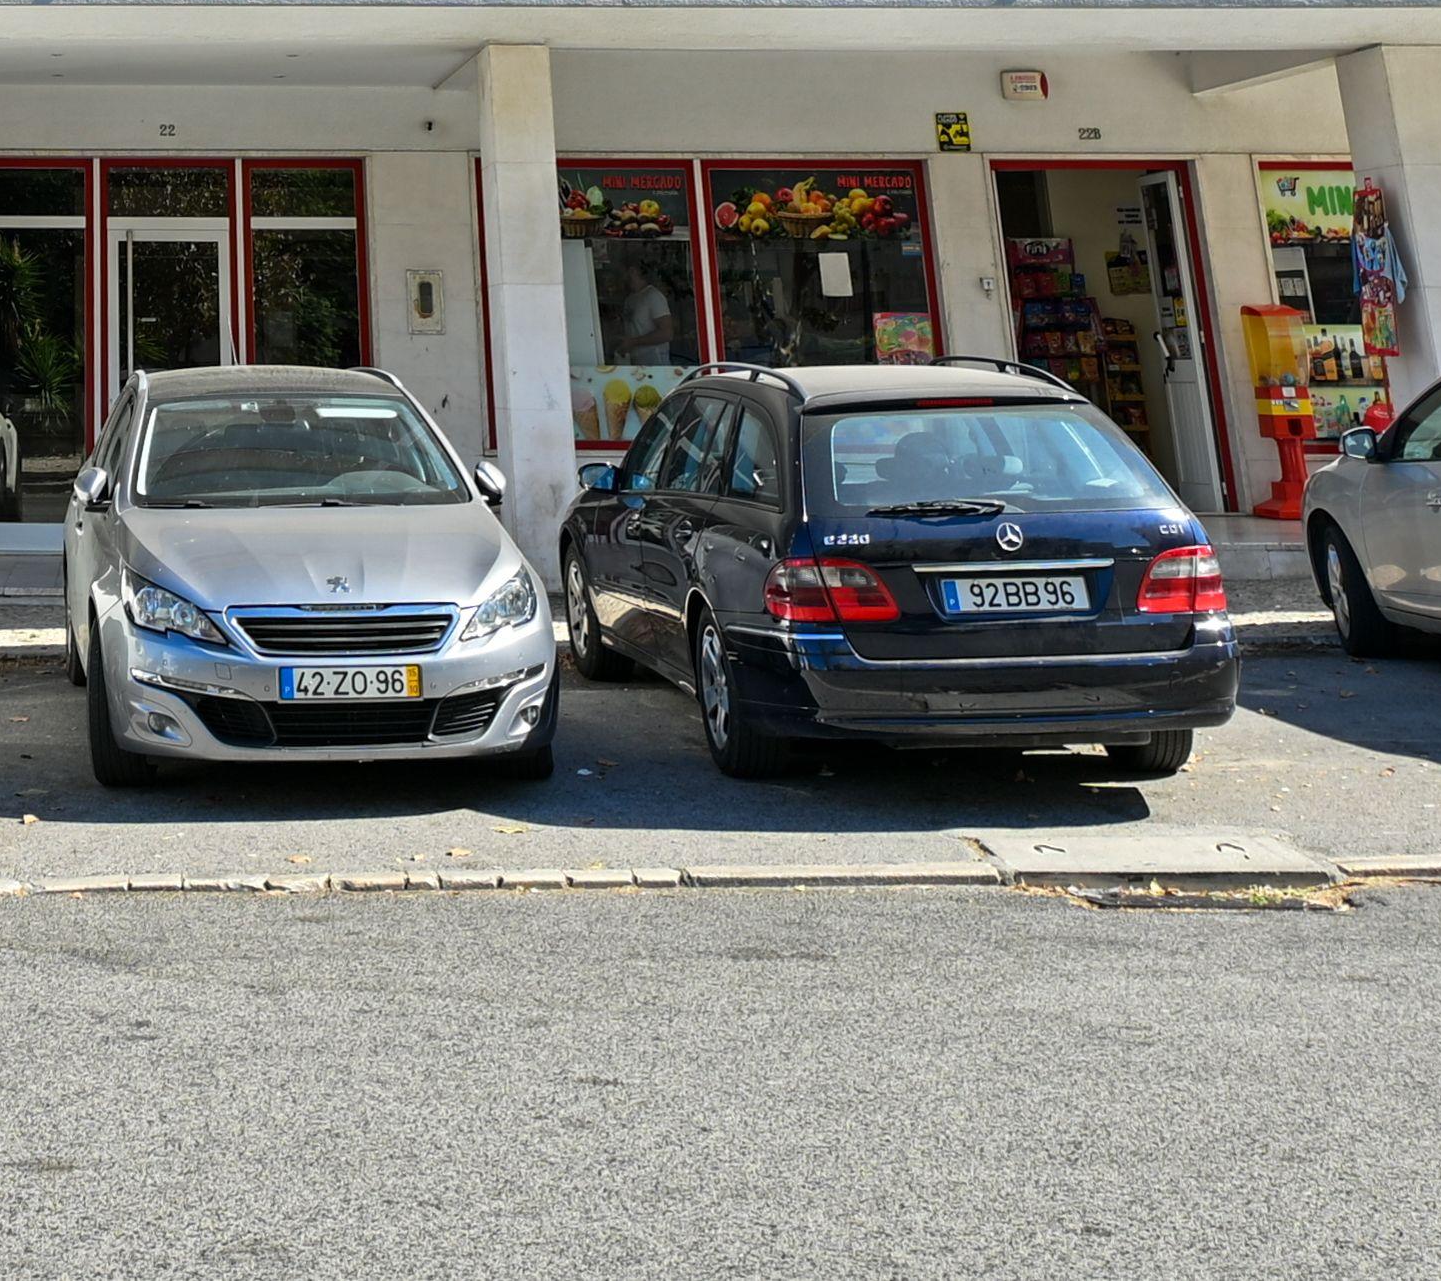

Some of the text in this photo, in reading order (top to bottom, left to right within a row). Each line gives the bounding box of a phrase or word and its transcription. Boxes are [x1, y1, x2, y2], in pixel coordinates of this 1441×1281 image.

[159, 124, 176, 137] 22
[1078, 127, 1102, 140] 22B
[602, 176, 682, 189] MINI MERCADO
[837, 175, 912, 188] MINI MERCADO
[1306, 186, 1356, 216] MIN
